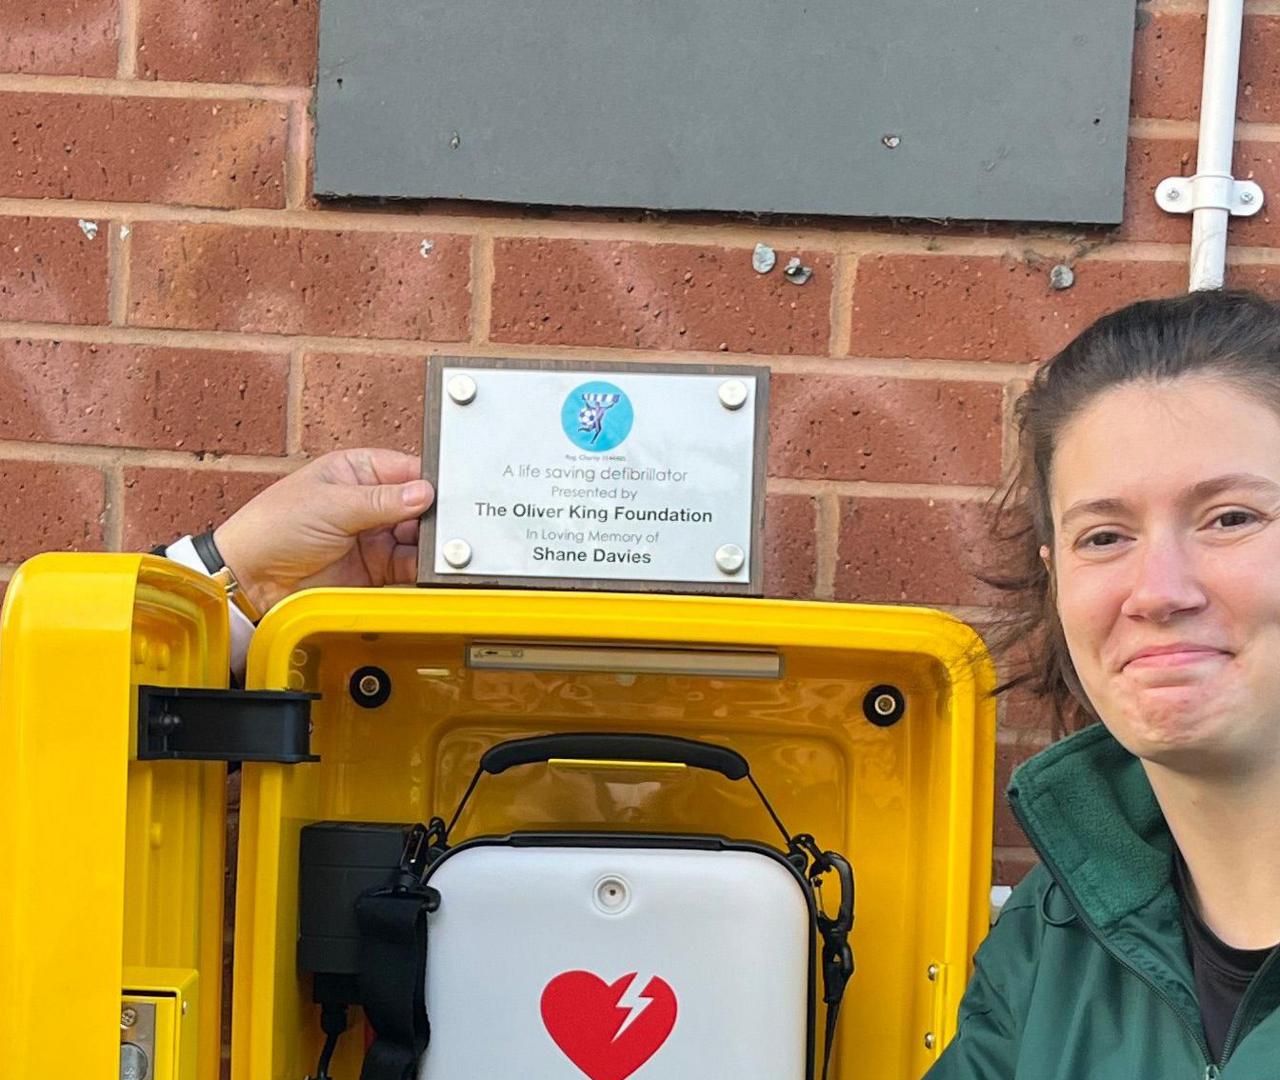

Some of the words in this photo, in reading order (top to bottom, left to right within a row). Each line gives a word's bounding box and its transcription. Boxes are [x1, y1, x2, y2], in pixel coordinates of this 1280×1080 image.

[502, 464, 514, 477] A
[519, 464, 541, 478] life
[545, 466, 595, 482] saving
[600, 466, 688, 482] defibrillator
[551, 486, 617, 499] Presented
[621, 488, 638, 501] by
[475, 502, 507, 517] The
[513, 503, 564, 518] Oliver
[569, 505, 608, 522] King
[614, 506, 713, 523] Foundation
[526, 528, 538, 540] In
[542, 528, 585, 544] Loving
[588, 531, 643, 545] Memory
[646, 532, 660, 544] of
[532, 546, 587, 562] Shane
[593, 548, 652, 564] Davies
